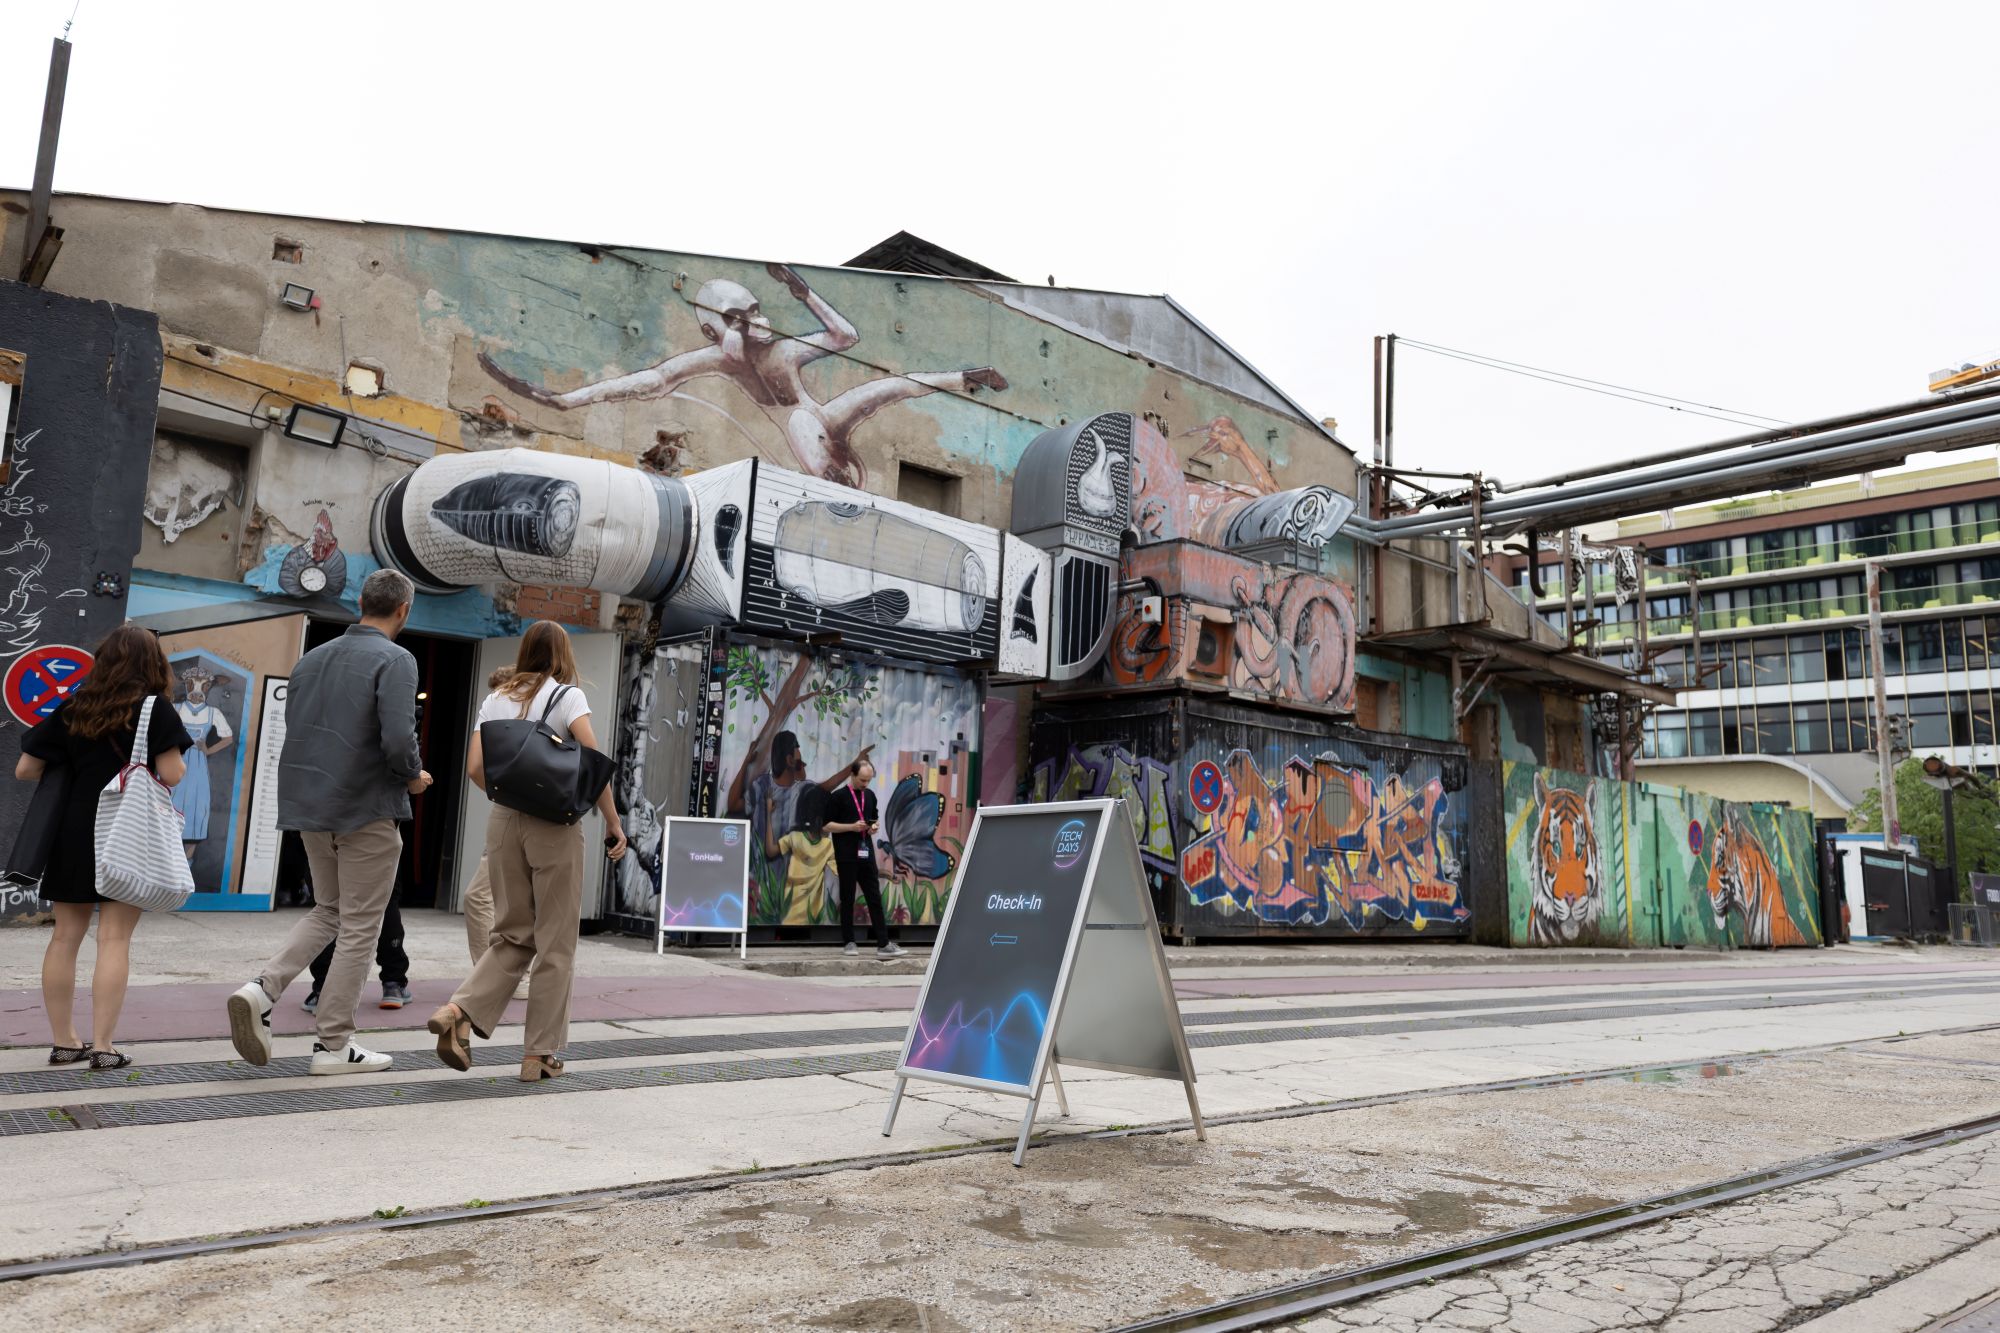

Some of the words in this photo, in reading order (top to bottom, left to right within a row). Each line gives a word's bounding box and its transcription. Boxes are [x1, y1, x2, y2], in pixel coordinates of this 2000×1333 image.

[1060, 830, 1083, 841] TECH
[1057, 842, 1079, 853] DAYS
[690, 852, 723, 863] TonHalle
[987, 894, 1042, 911] Check-In
